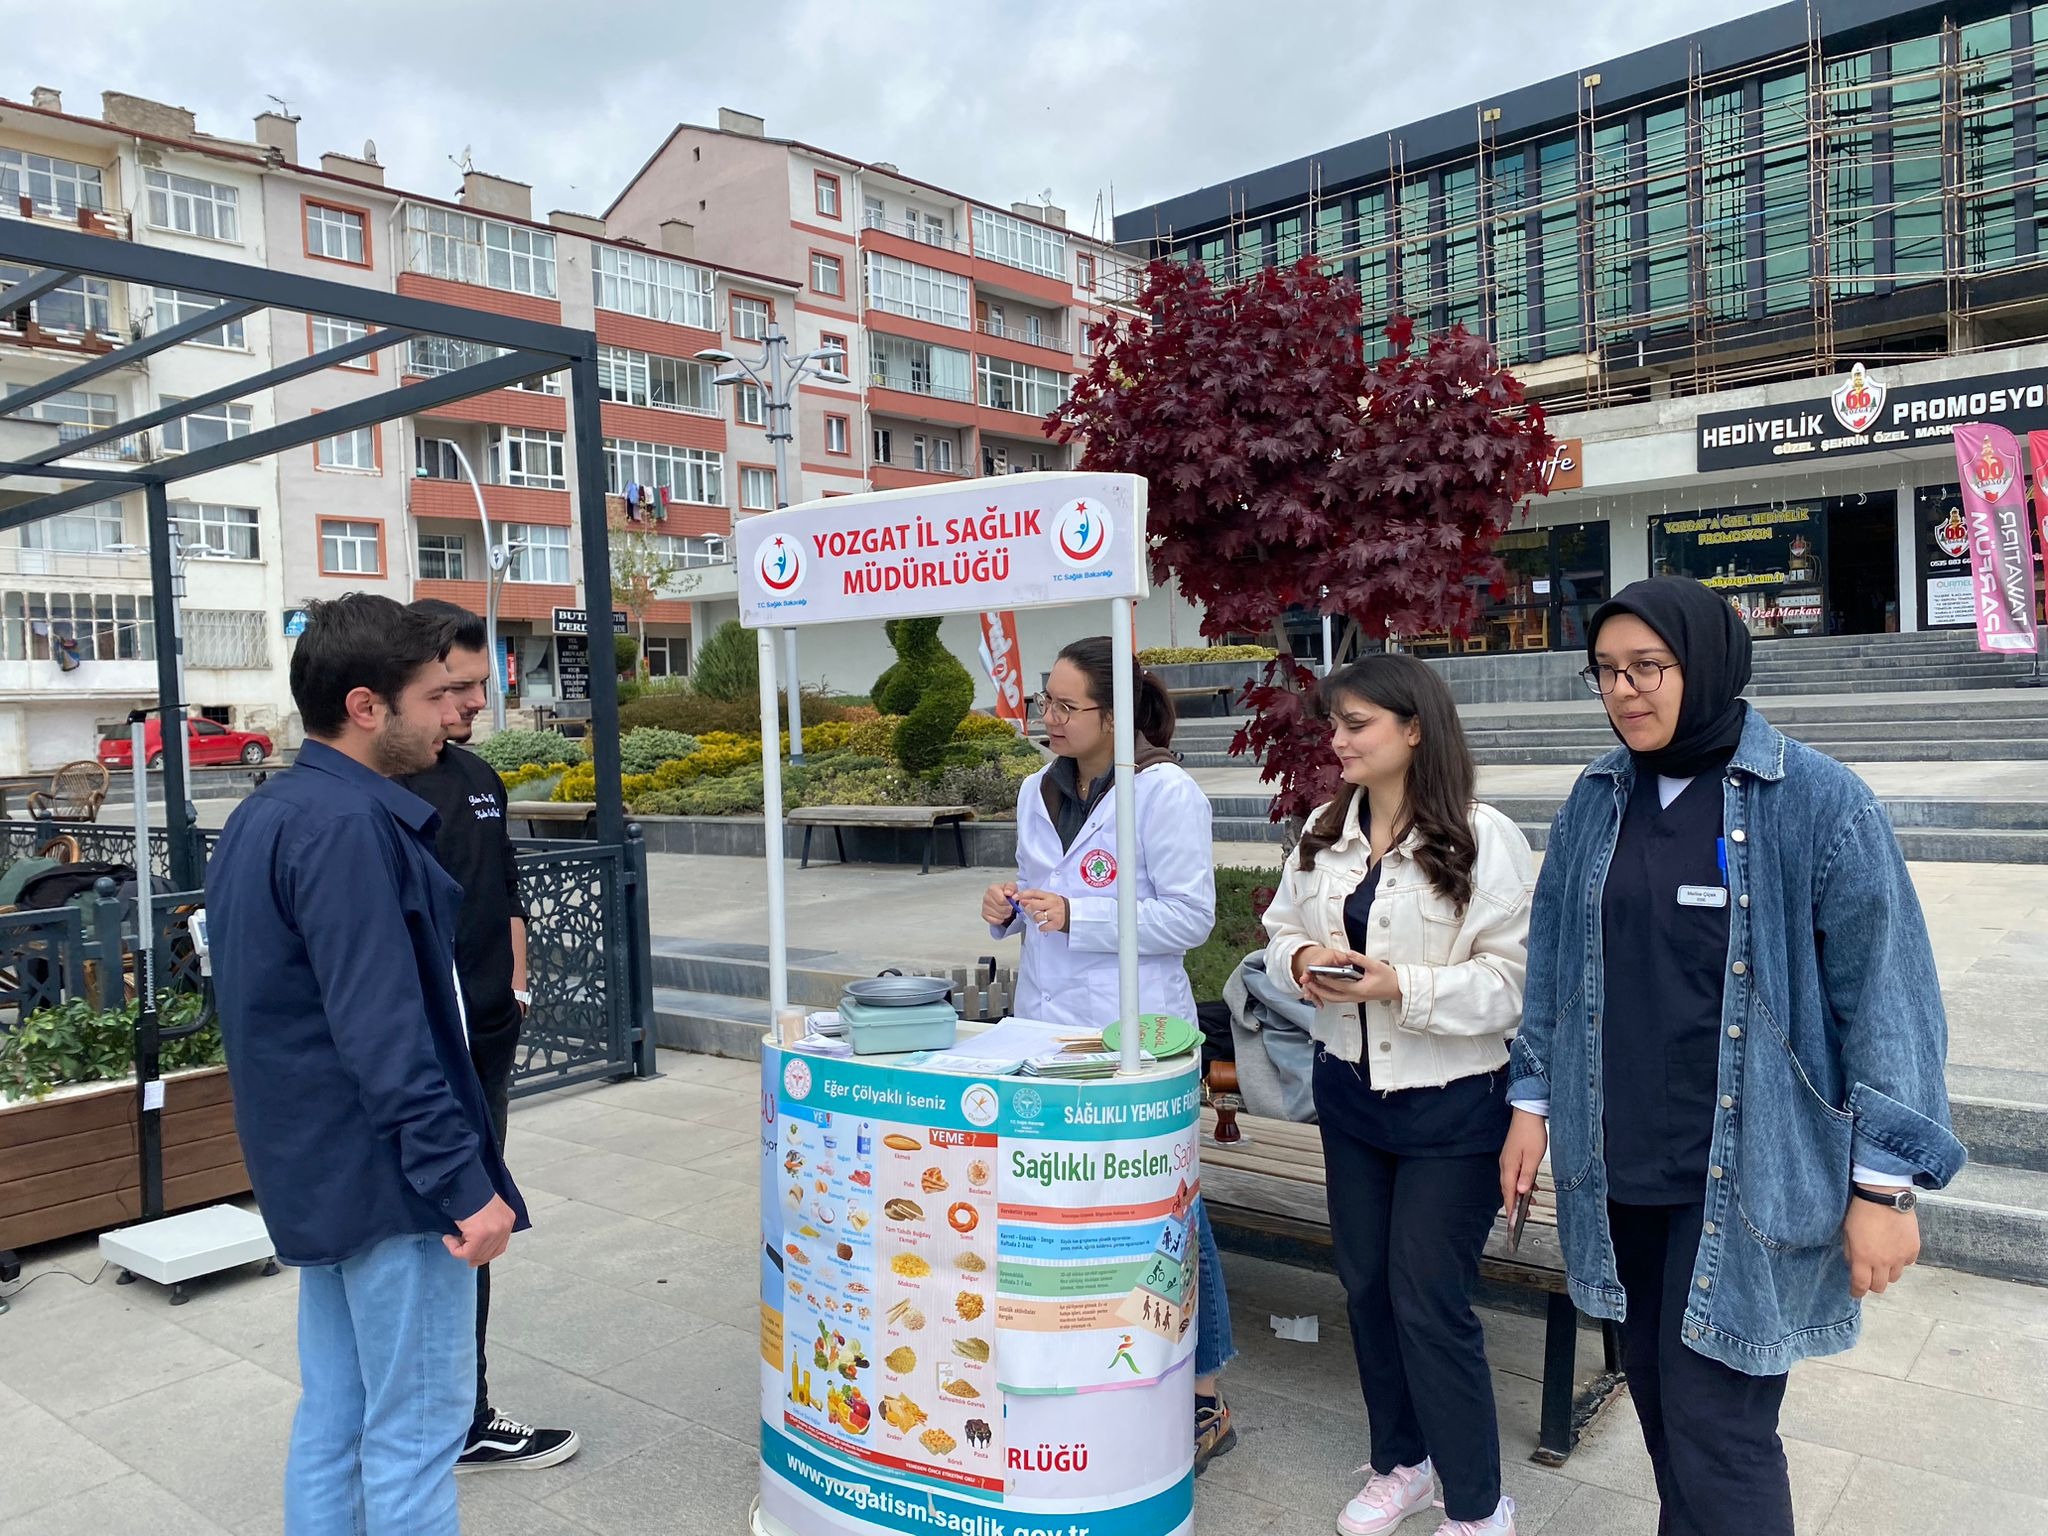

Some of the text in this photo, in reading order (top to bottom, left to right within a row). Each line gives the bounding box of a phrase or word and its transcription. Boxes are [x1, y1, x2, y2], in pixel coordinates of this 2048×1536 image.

[1703, 384, 2048, 449] HEDİYELİK PROMOSYO
[1821, 434, 1869, 451] ŞEHRİN
[1873, 430, 1909, 445] ÖZEL
[1915, 421, 1978, 439] MARK
[812, 506, 1041, 558] YOZGAT İL SAĞLIK
[843, 547, 1010, 595] MÜDÜRLÜĞÜ
[1752, 605, 1821, 618] Özel Markası
[824, 1080, 946, 1110] Eğer Çölyaklı iseniz
[1064, 1102, 1127, 1125] SAĞLIKLI
[1131, 1099, 1169, 1122] YEMEK
[1172, 1097, 1182, 1116] VE
[931, 1129, 965, 1144] YEME
[1012, 1150, 1095, 1187] Sağlıklı
[1104, 1149, 1172, 1179] Beslen,
[969, 1187, 991, 1195] Bazlama
[898, 1281, 920, 1289] Makarna
[961, 1274, 979, 1282] Bulgur
[887, 1329, 899, 1337] Arpa
[1005, 1444, 1088, 1472] RLÜĞÜ
[787, 1453, 1089, 1536] www.yozgatism.saglikgovtr
